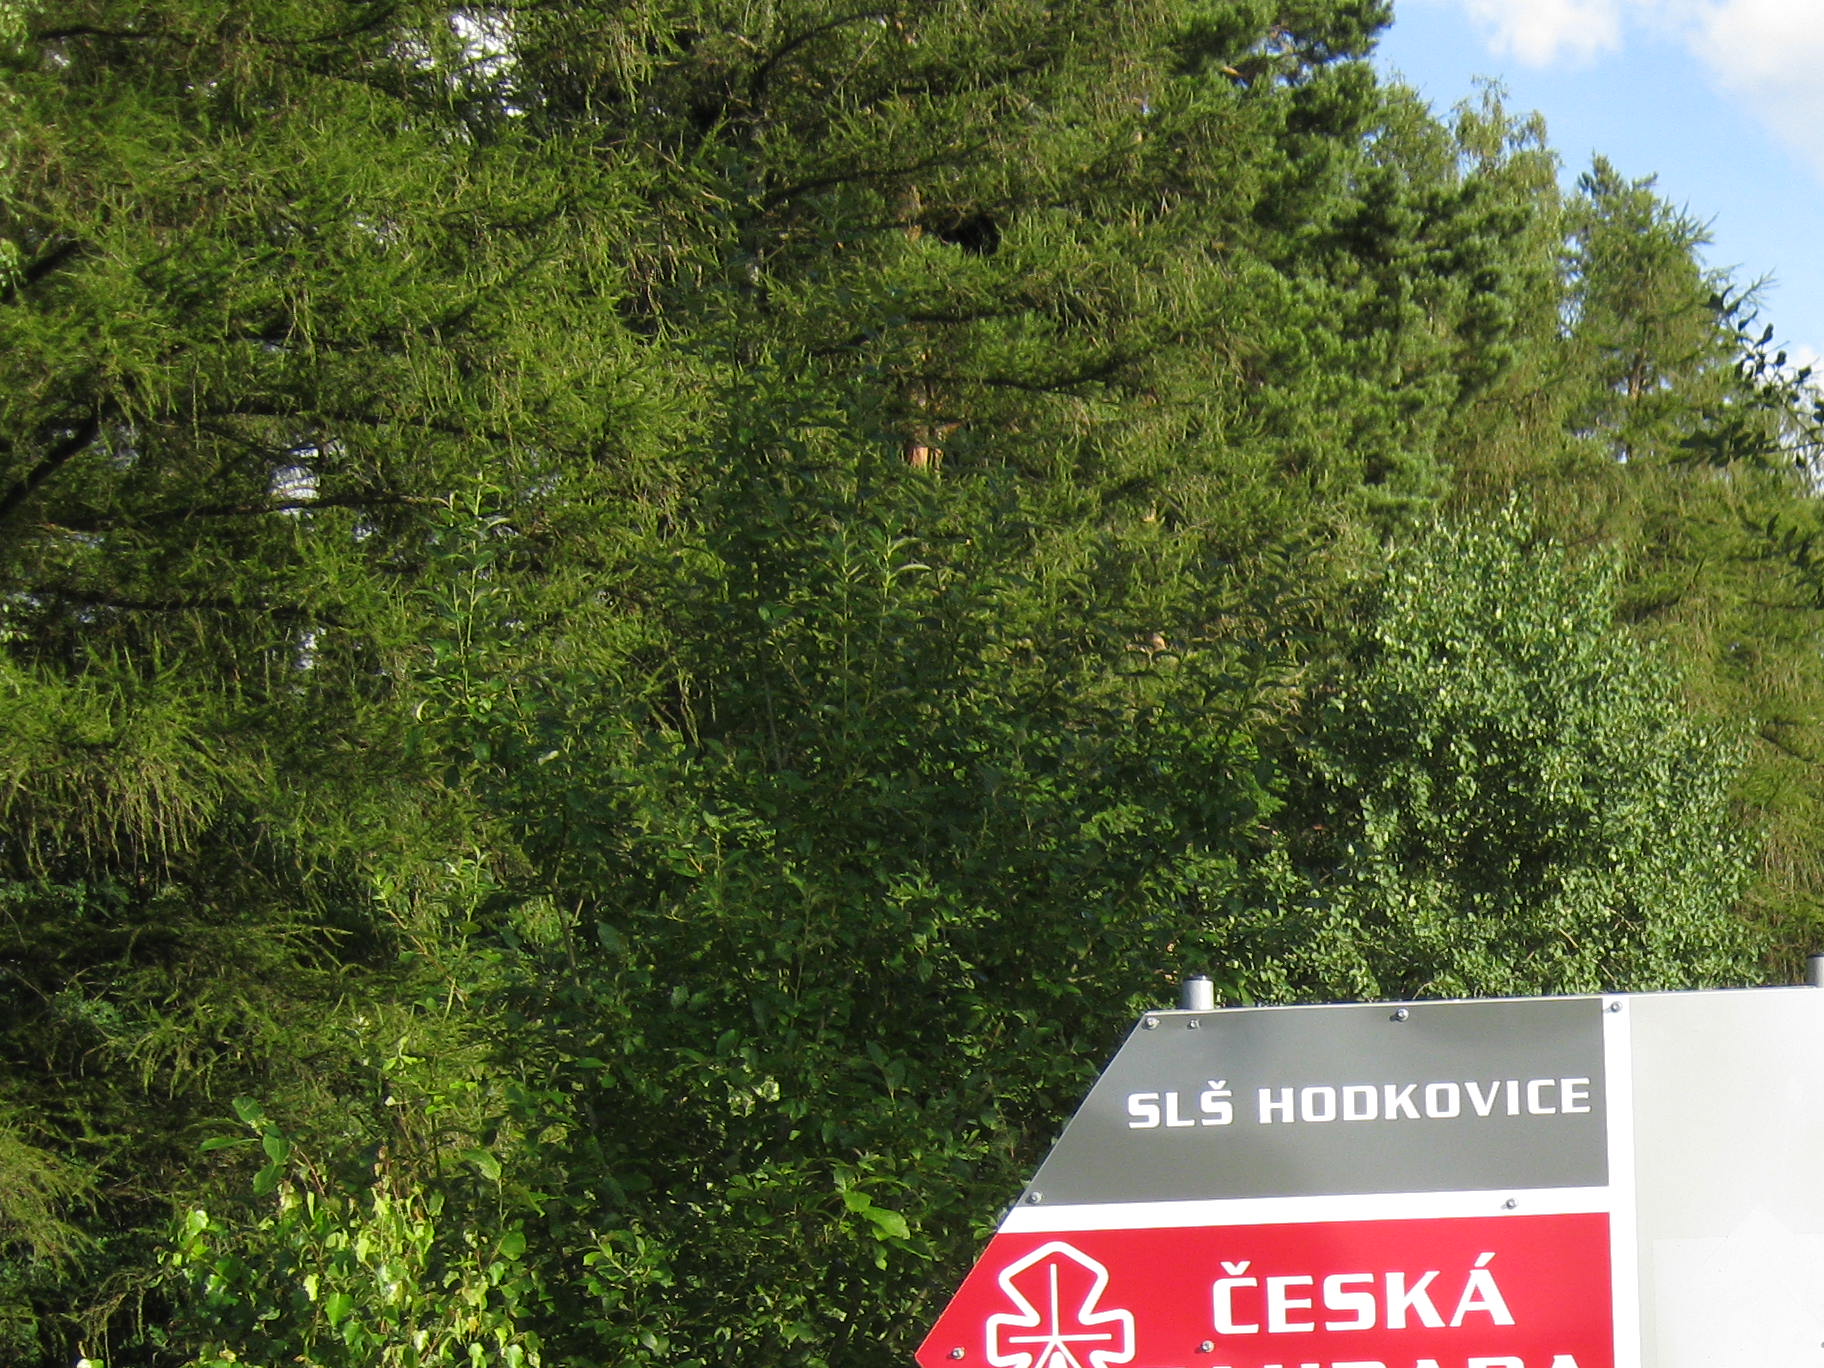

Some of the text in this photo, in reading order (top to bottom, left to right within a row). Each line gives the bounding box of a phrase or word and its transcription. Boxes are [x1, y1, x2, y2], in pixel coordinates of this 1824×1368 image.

[1127, 1076, 1592, 1130] SLŠ HODKOVICE
[1212, 1250, 1517, 1336] ČESKÁ
